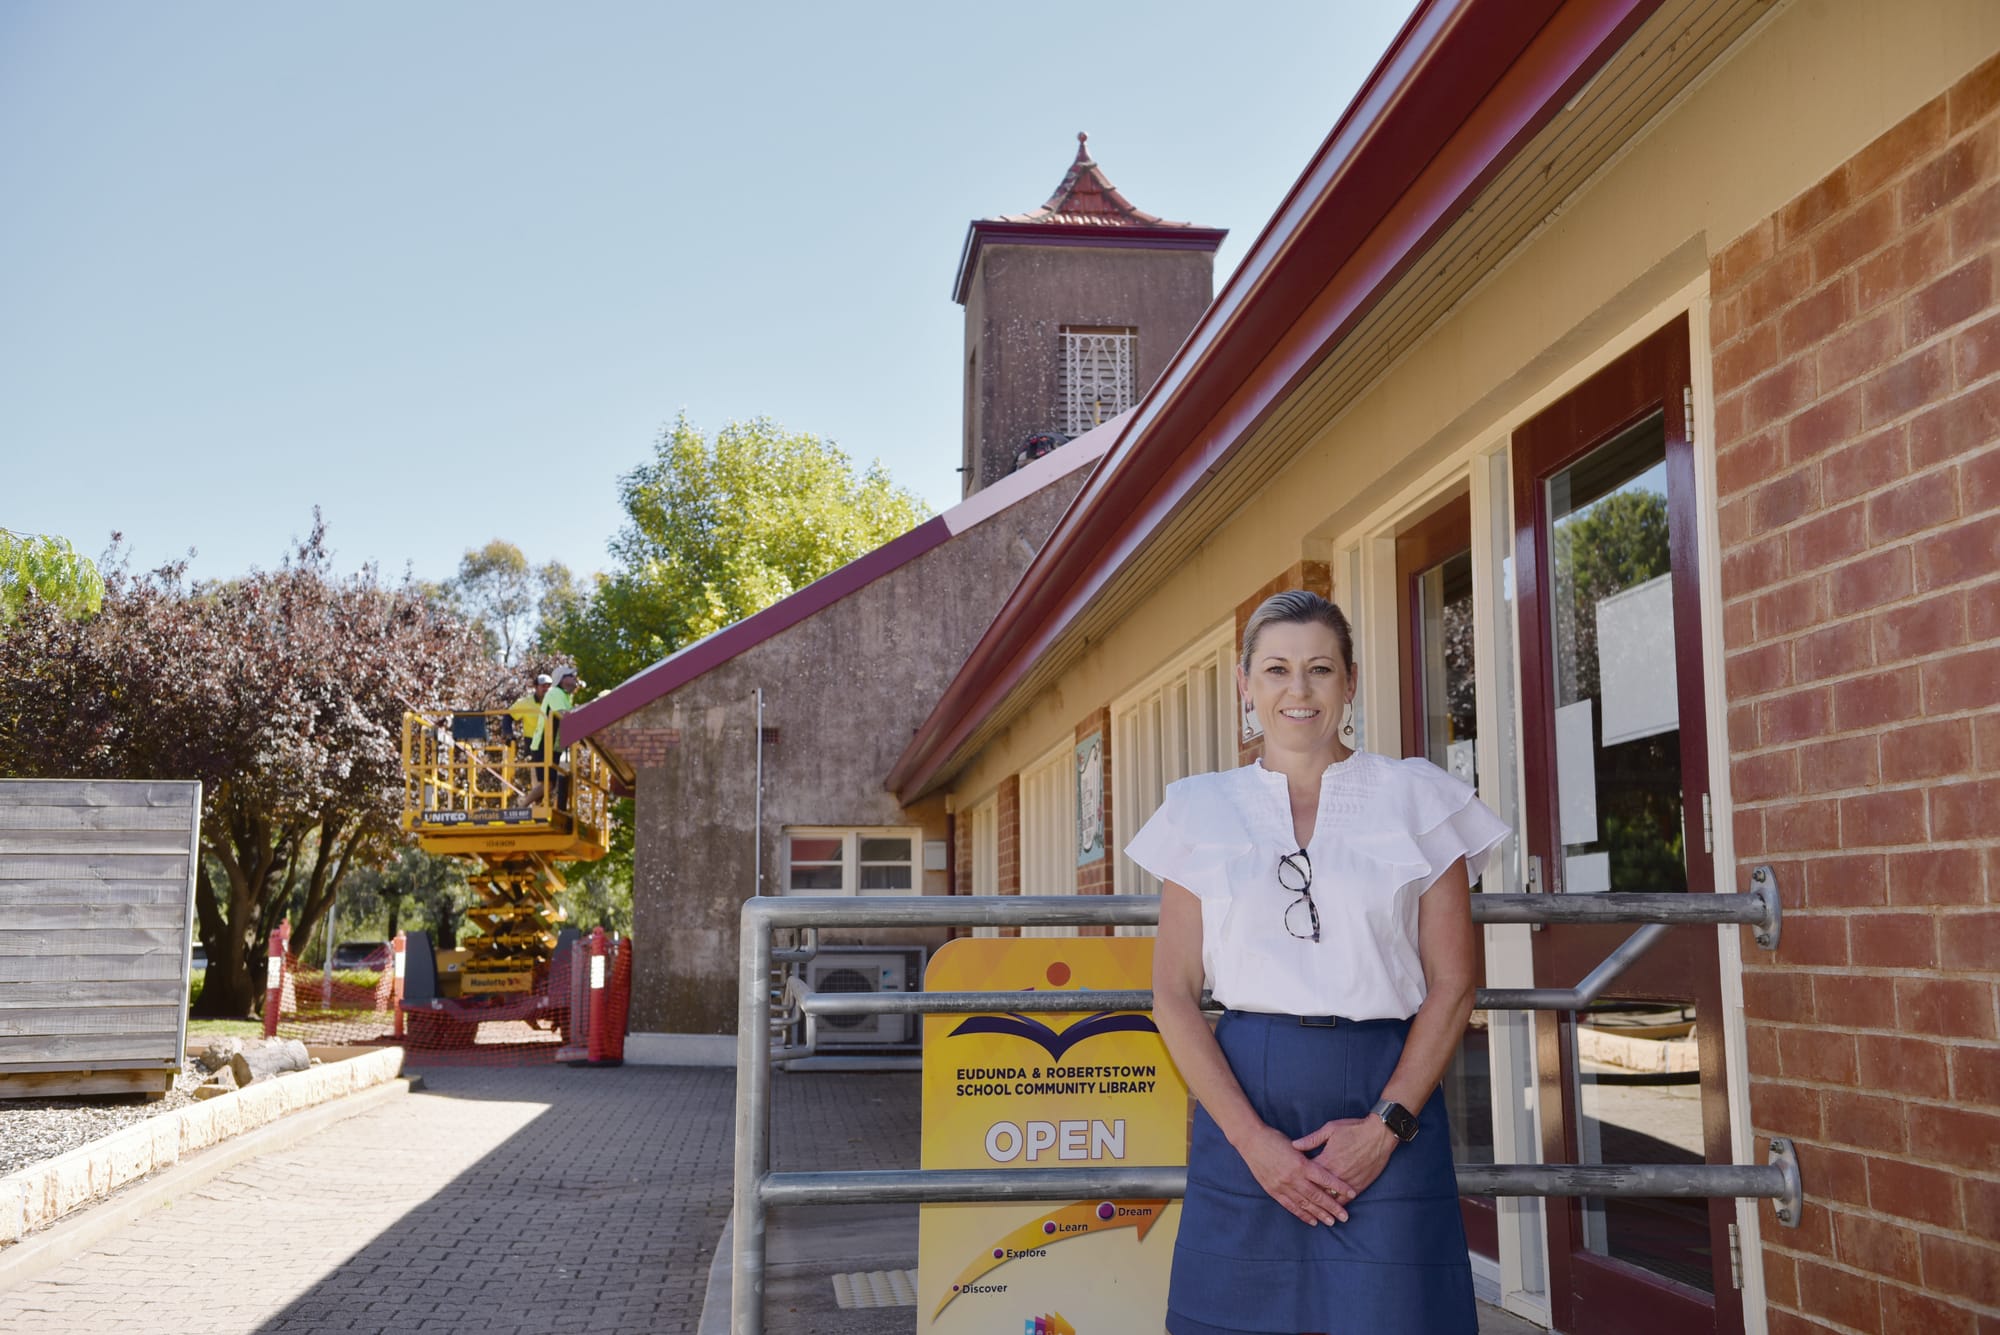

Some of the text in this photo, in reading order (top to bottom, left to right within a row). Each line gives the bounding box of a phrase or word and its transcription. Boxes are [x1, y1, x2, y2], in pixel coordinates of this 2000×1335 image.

[424, 813, 466, 822] UNITED
[957, 1066, 1156, 1080] EUDUNDA & ROBERTSTOWN
[956, 1081, 1156, 1096] SCHOOL COMMUNITY LIBRARY
[984, 1119, 1126, 1163] OPEN
[1118, 1207, 1152, 1217] Dream
[1059, 1223, 1088, 1232] Learn
[1006, 1249, 1047, 1260] Explore
[962, 1284, 1008, 1294] Discover
